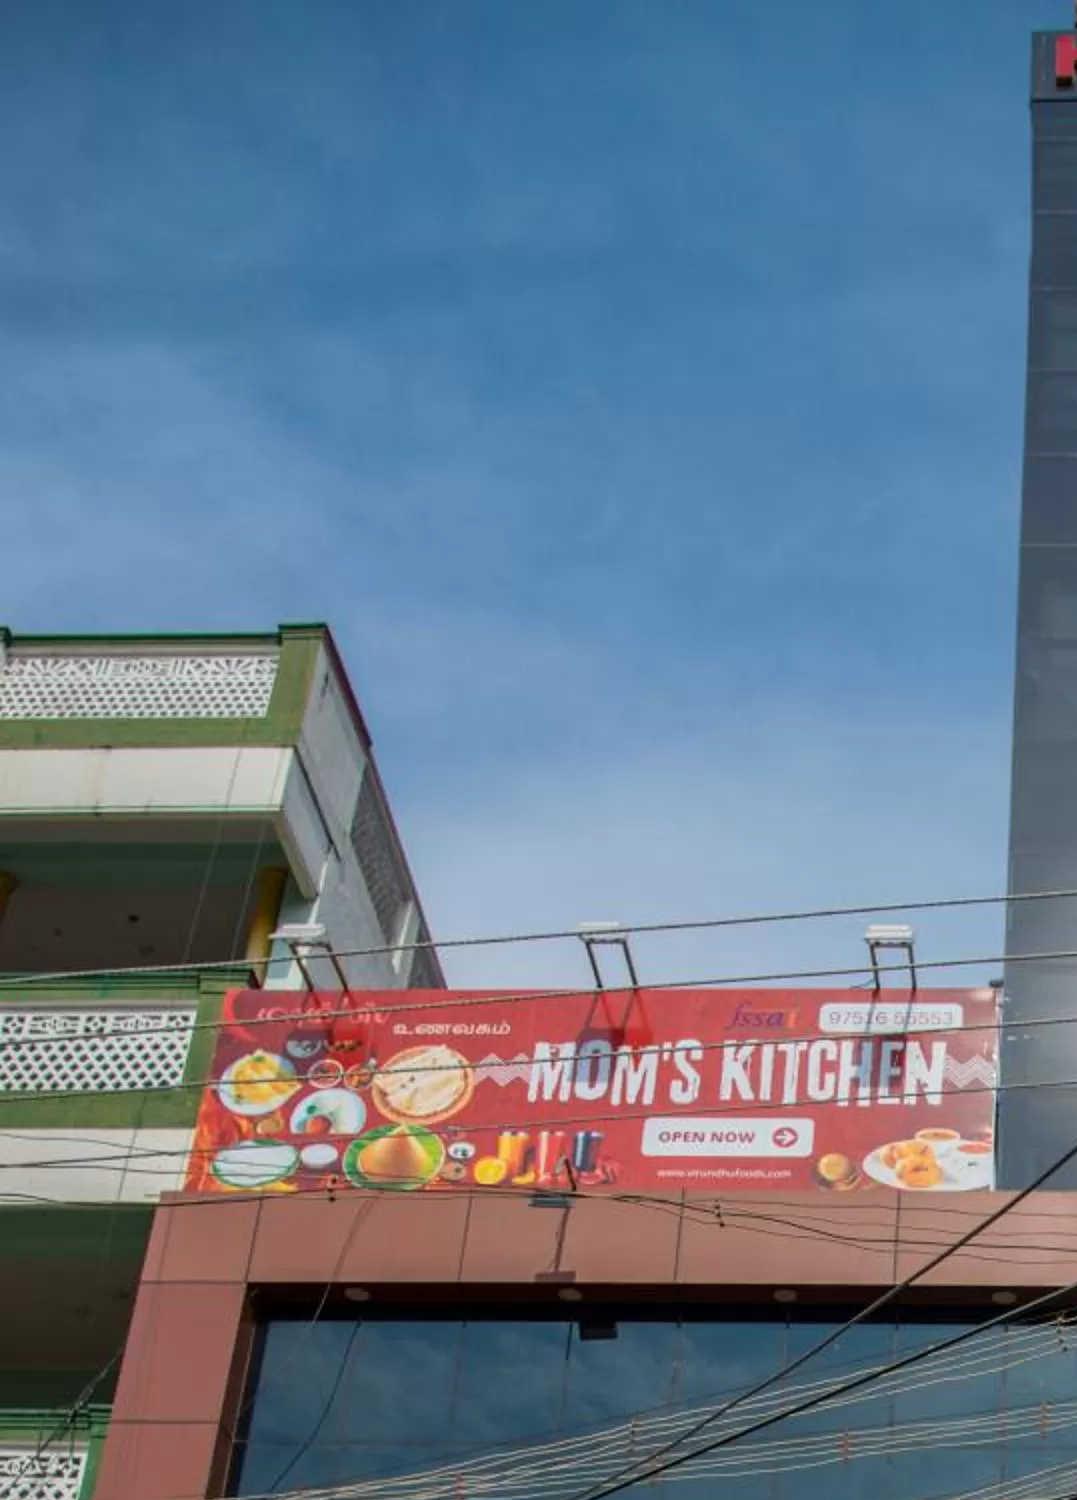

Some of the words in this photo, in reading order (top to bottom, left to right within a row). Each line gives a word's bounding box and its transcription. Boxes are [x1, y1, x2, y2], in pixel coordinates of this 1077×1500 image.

[527, 1038, 704, 1106] MOM'S
[719, 1038, 948, 1108] KITCHEN
[658, 1131, 705, 1144] OPEN
[710, 1131, 756, 1144] NOW
